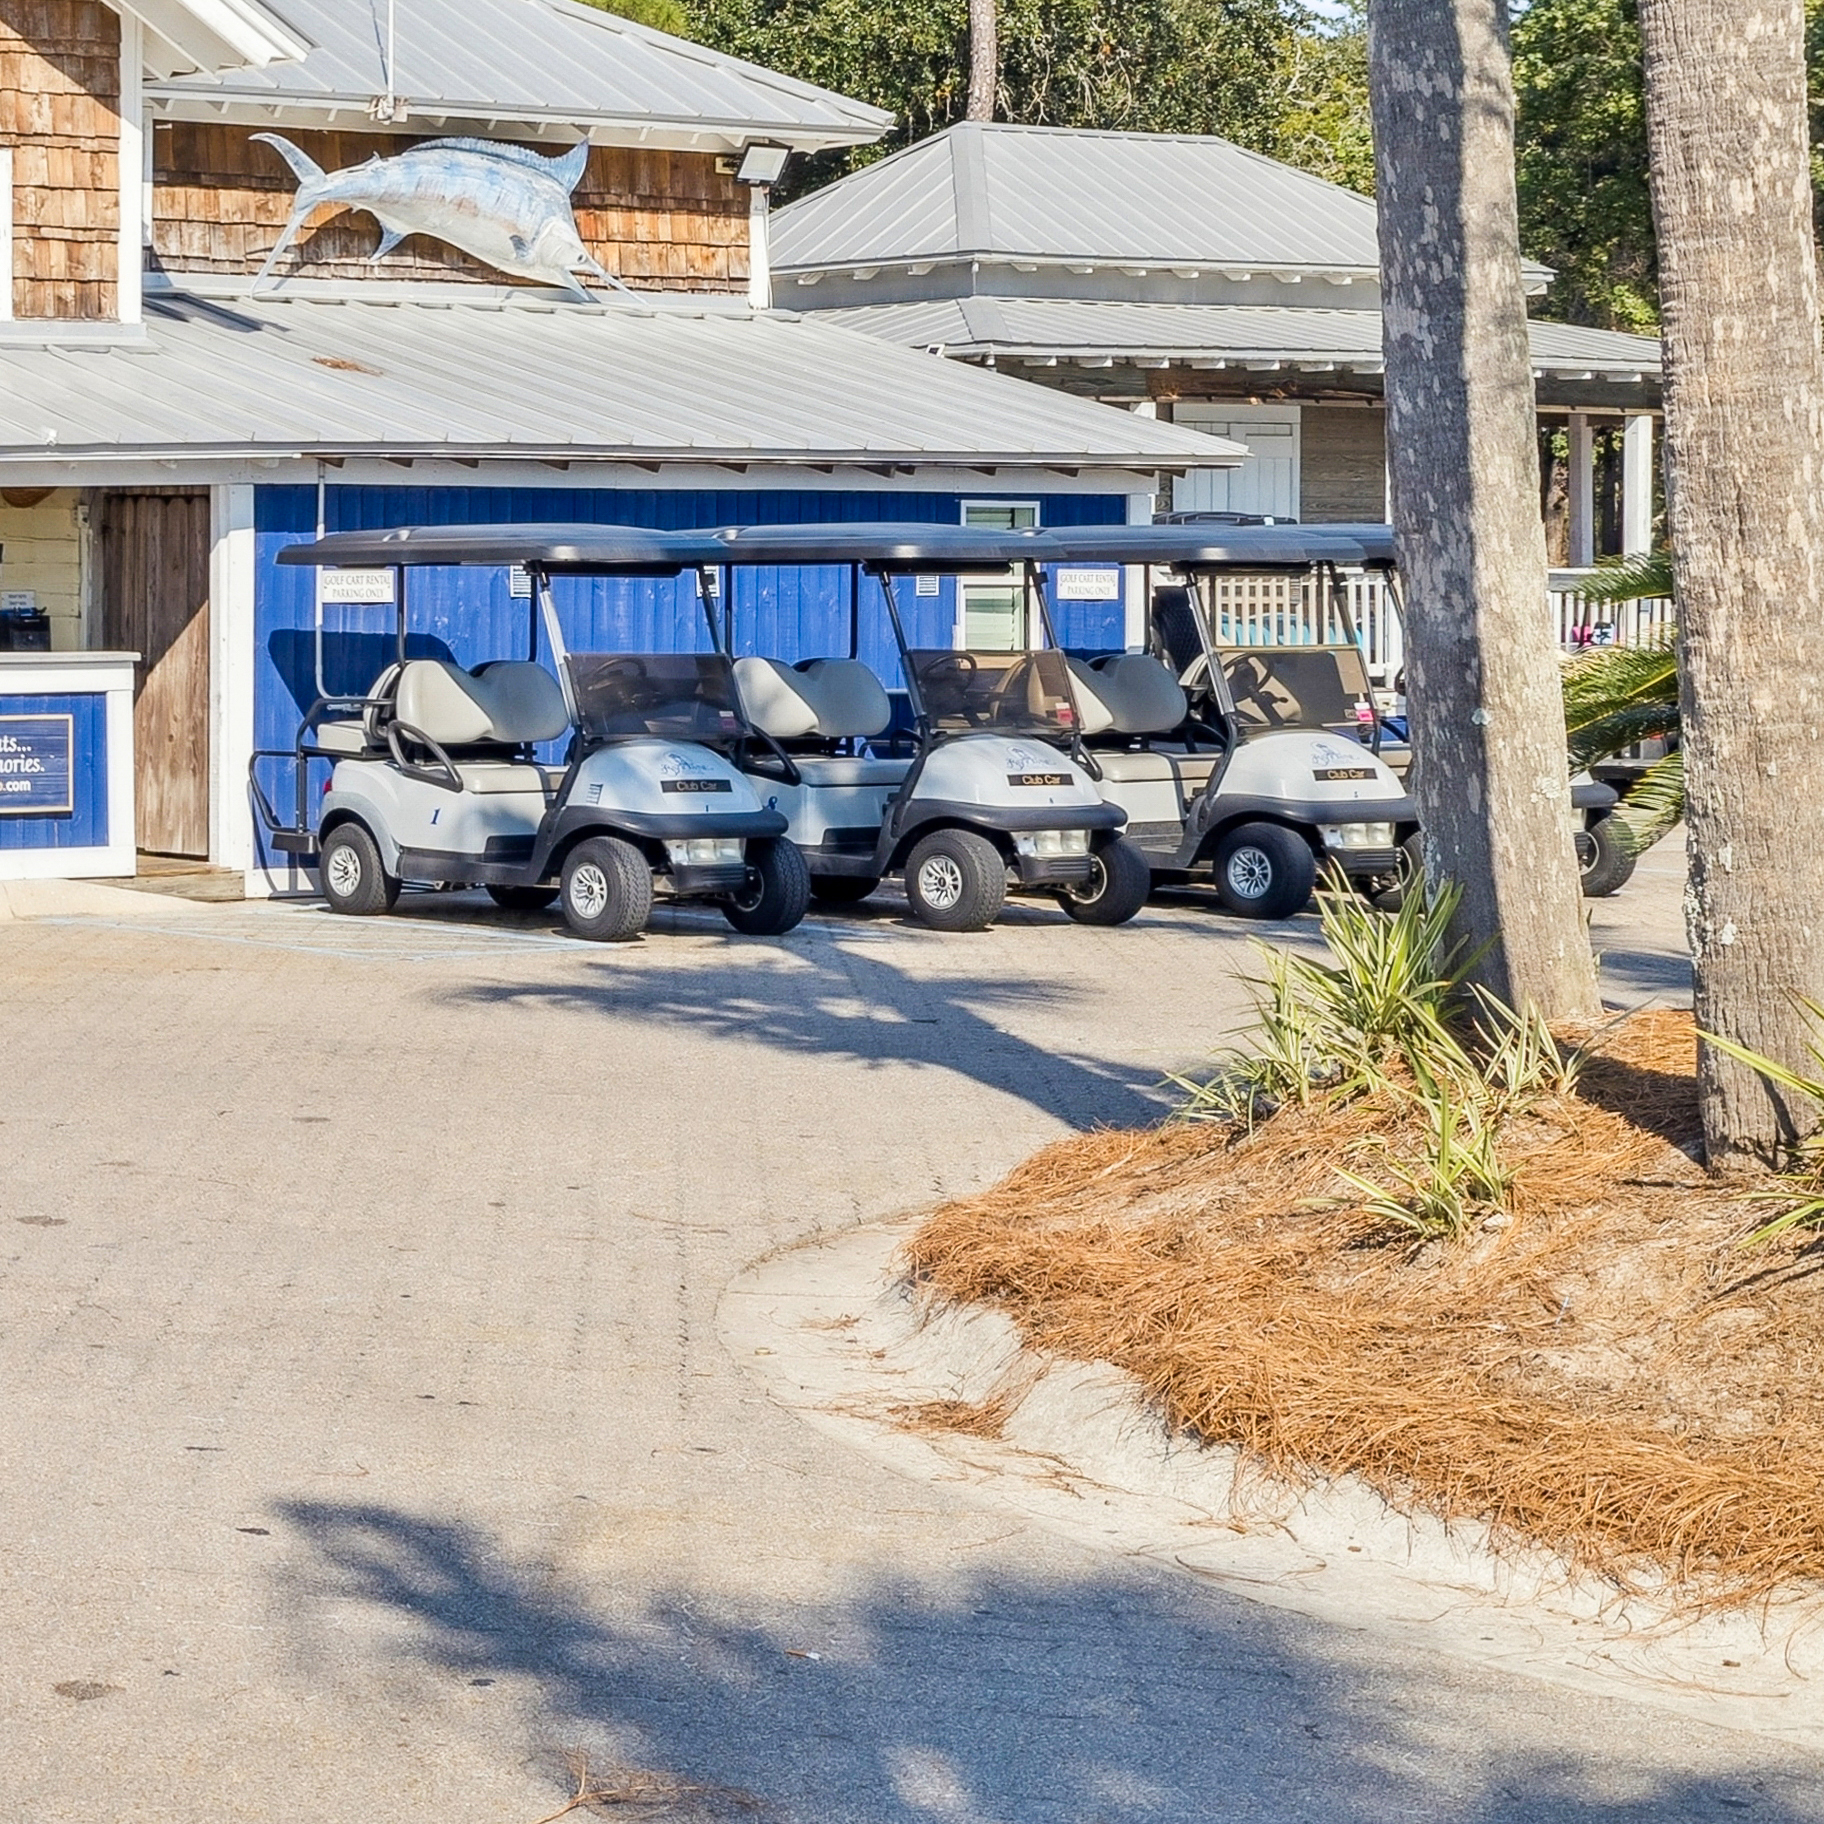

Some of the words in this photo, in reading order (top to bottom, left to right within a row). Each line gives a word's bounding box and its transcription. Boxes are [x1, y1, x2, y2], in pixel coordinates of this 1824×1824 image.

[324, 575, 344, 585] GOLF
[346, 575, 364, 585] CART
[365, 574, 391, 585] RENTAL
[1060, 574, 1077, 583] GOLF
[1078, 574, 1094, 583] CART
[332, 588, 364, 598] PARKING
[365, 588, 384, 598] ONLY
[1326, 770, 1348, 779] Club
[1349, 769, 1365, 779] Car
[1022, 775, 1043, 785] Club
[1044, 775, 1061, 784] Car
[676, 781, 699, 791] Club
[700, 781, 718, 791] Car
[430, 808, 441, 825] 1
